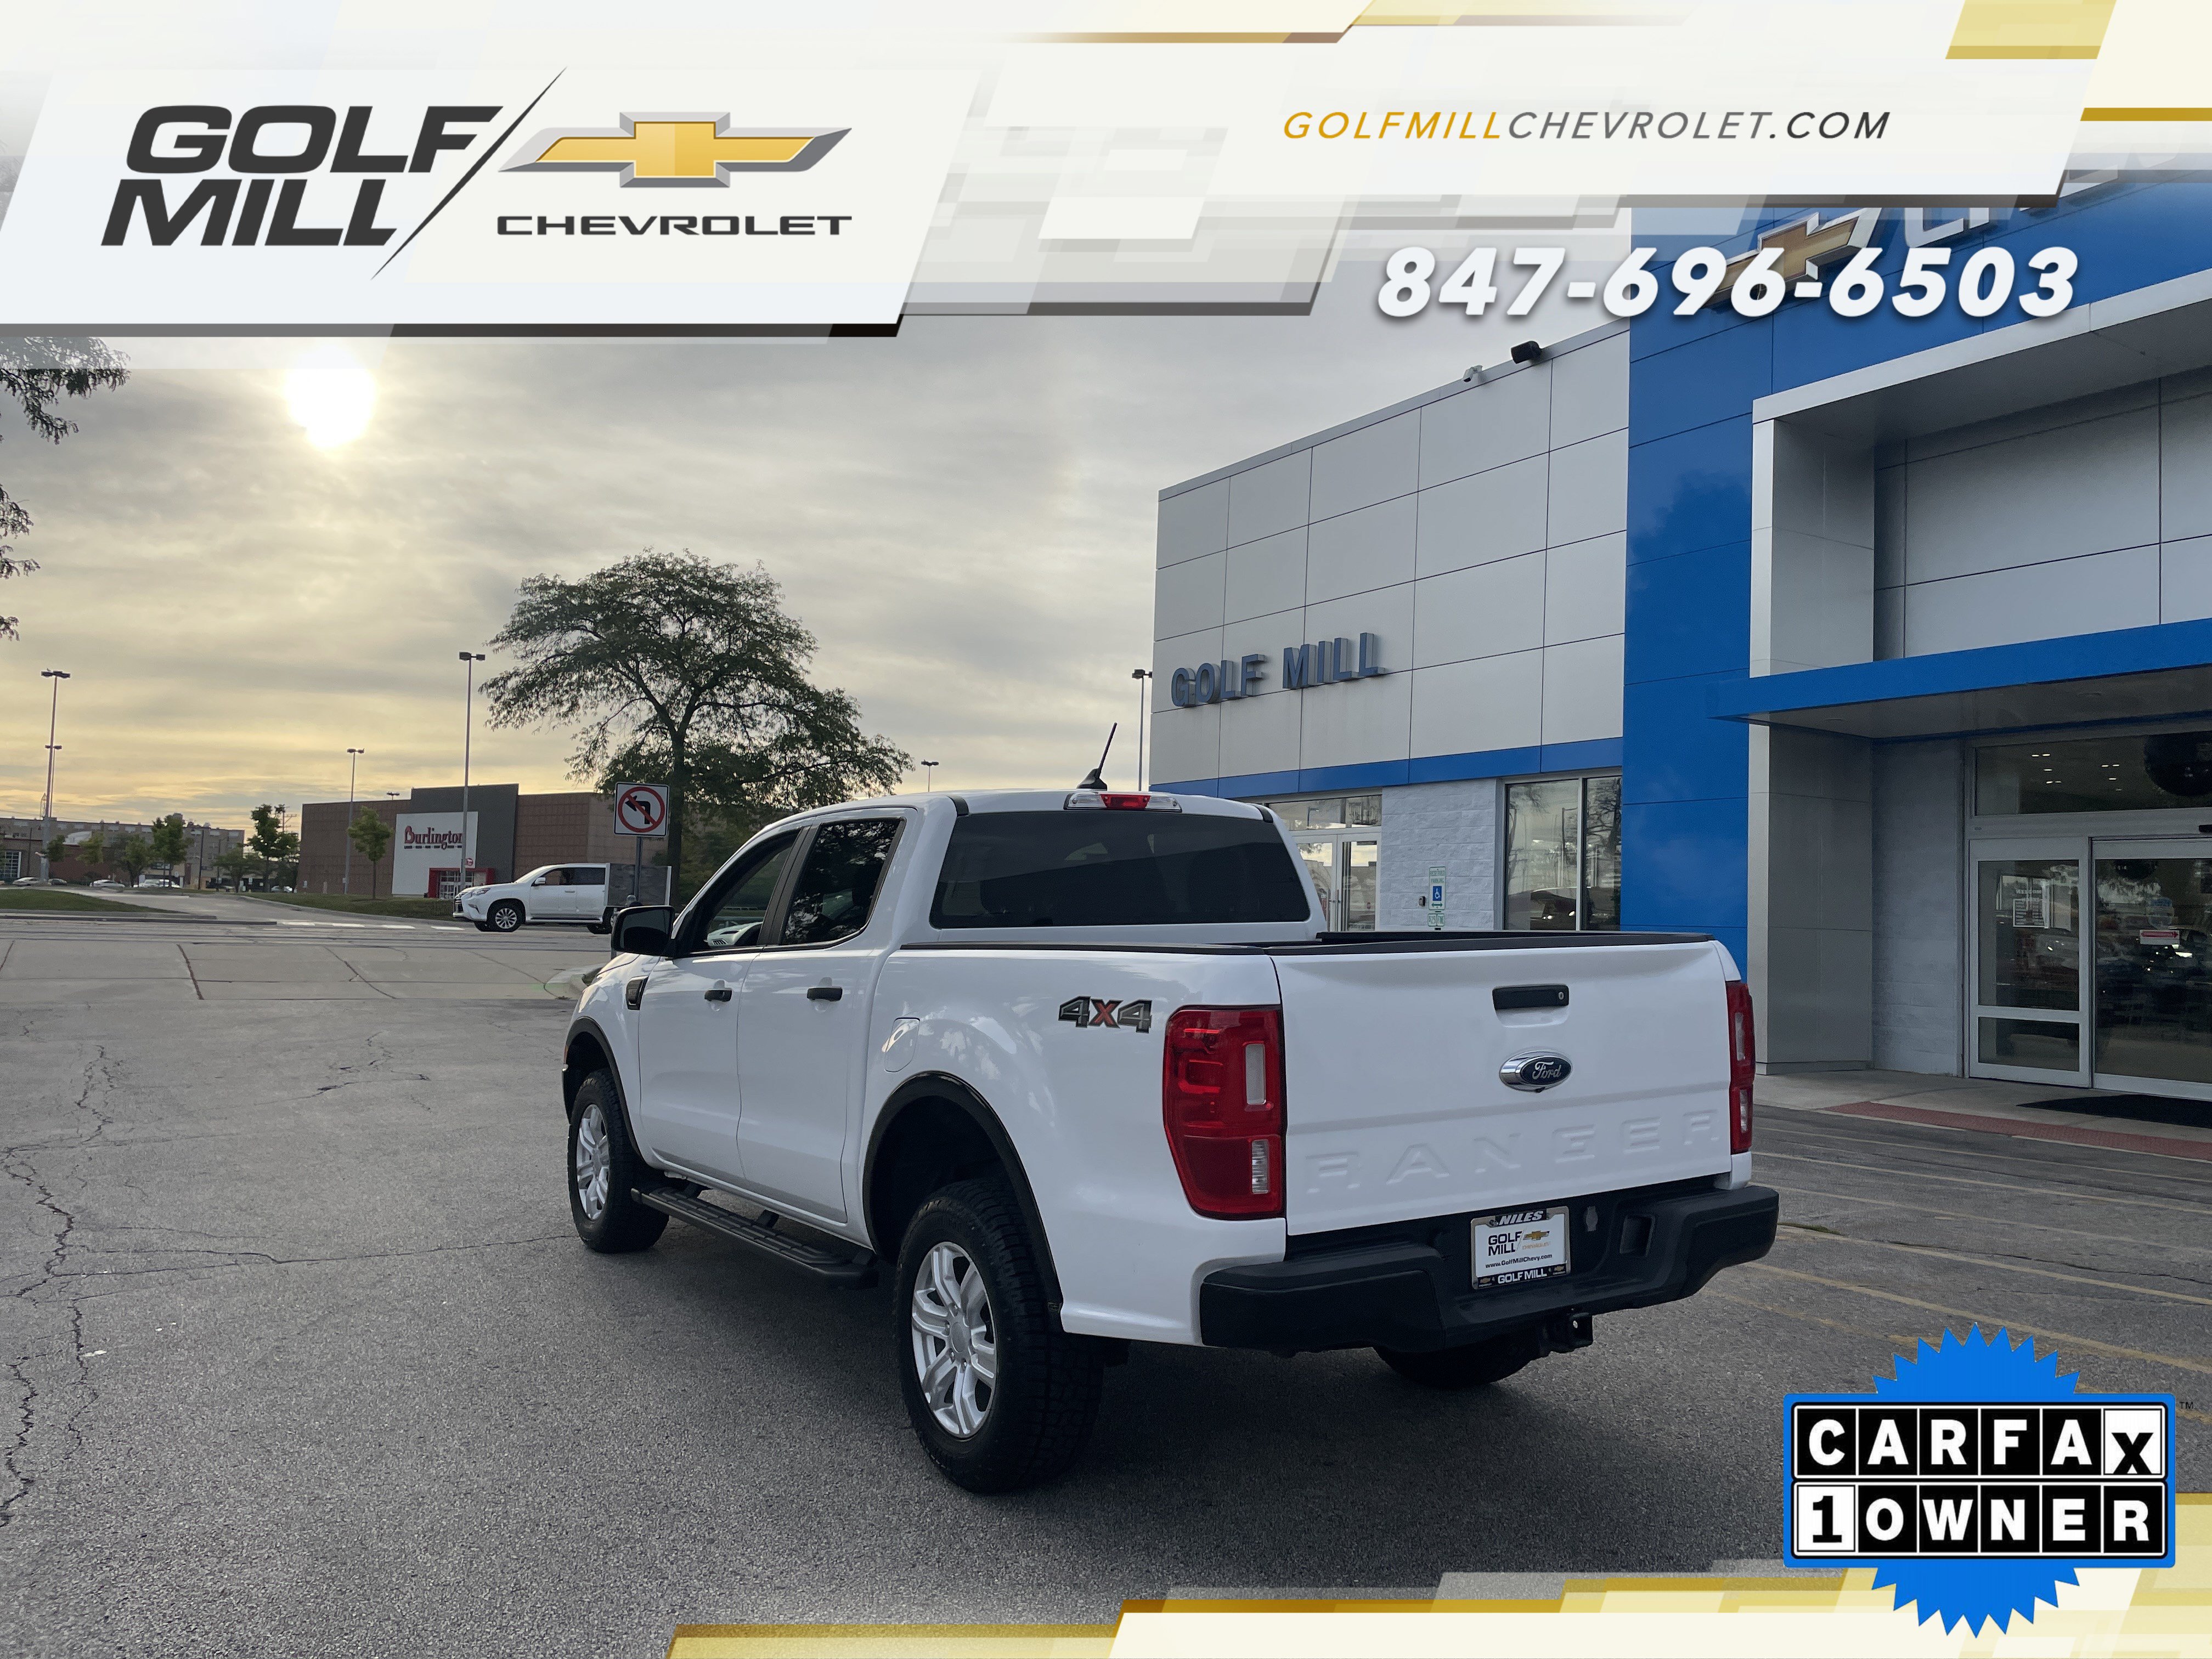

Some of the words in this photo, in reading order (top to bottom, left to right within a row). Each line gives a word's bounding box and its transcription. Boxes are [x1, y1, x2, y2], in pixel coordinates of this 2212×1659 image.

[1171, 653, 1268, 708] GOLF
[1283, 632, 1386, 689] MILL
[1532, 1061, 1562, 1080] Ford
[1305, 1108, 1720, 1195] RANGER
[1499, 1211, 1543, 1226] NILES
[1488, 1231, 1523, 1246] GOLF
[1488, 1243, 1516, 1256] MILL
[1485, 1254, 1553, 1269] www.GolfMillChevy.com
[1498, 1272, 1523, 1284] GOLF
[1524, 1268, 1548, 1280] MILL
